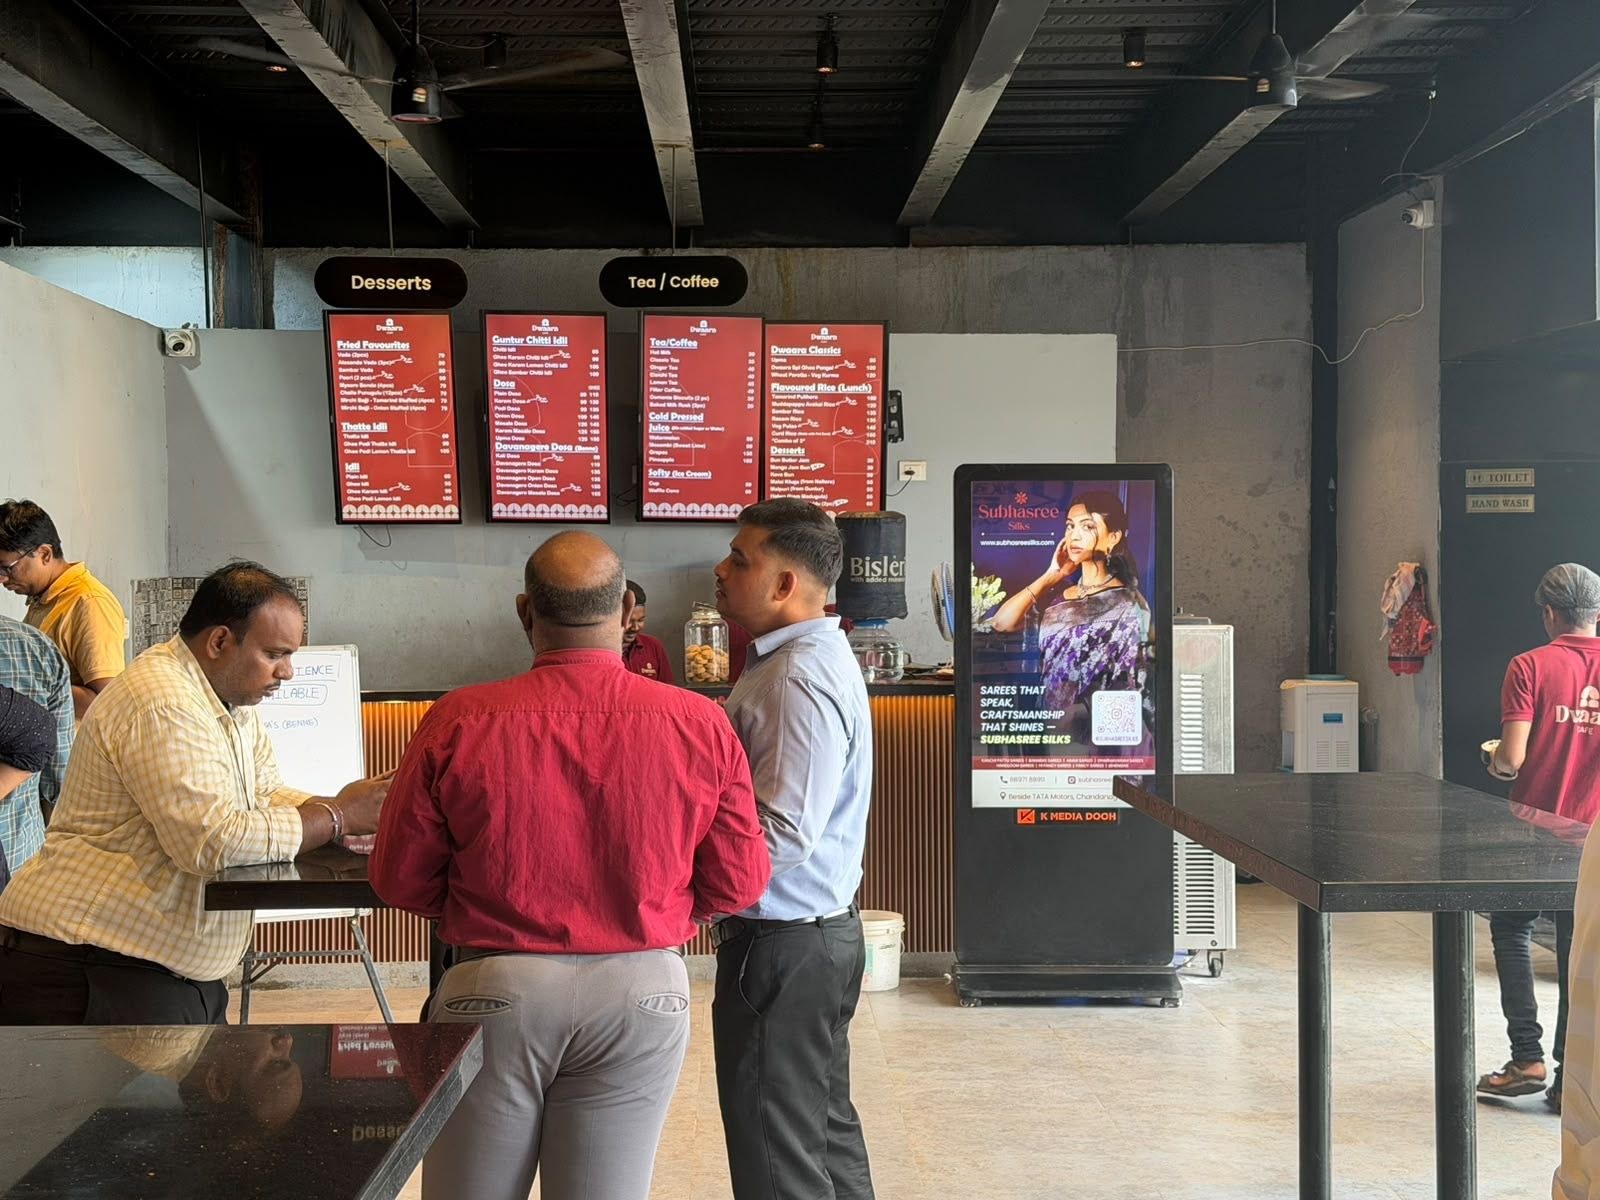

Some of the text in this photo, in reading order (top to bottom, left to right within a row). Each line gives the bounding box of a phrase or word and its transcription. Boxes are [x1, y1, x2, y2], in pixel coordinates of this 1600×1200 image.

[352, 275, 431, 290] Desserts
[628, 273, 719, 290] Tea / Coffee
[492, 335, 568, 344] Guntur Chitti Idli
[650, 338, 697, 347] Tea/Coffee
[337, 341, 410, 349] Fried Favourites
[771, 346, 841, 354] Dwaara Classics
[494, 379, 515, 388] Dosa
[771, 383, 815, 391] Flavoured
[838, 384, 872, 392] (Lunch)
[649, 412, 704, 421] Cold Pressed
[342, 422, 387, 430] Thatte Idli
[649, 423, 670, 433] Juice
[496, 442, 549, 451] Davanagere
[551, 443, 573, 451] Dosa
[771, 446, 805, 454] Desserts
[345, 463, 360, 471] Idli
[649, 468, 670, 477] Softy
[1488, 474, 1529, 482] TOILET
[1472, 499, 1529, 508] HAND WASH
[979, 505, 1059, 518] Subhasree
[1008, 521, 1030, 530] Silks
[295, 665, 334, 676] IENCE
[980, 686, 1046, 695] SAREES THAT
[980, 698, 1013, 708] SPEAK,
[980, 711, 1065, 719] CRAFTSMANSHIP
[981, 723, 1007, 731] THAT
[1009, 723, 1044, 731] SHINES
[980, 735, 1071, 744] SUBHASREE SILKS
